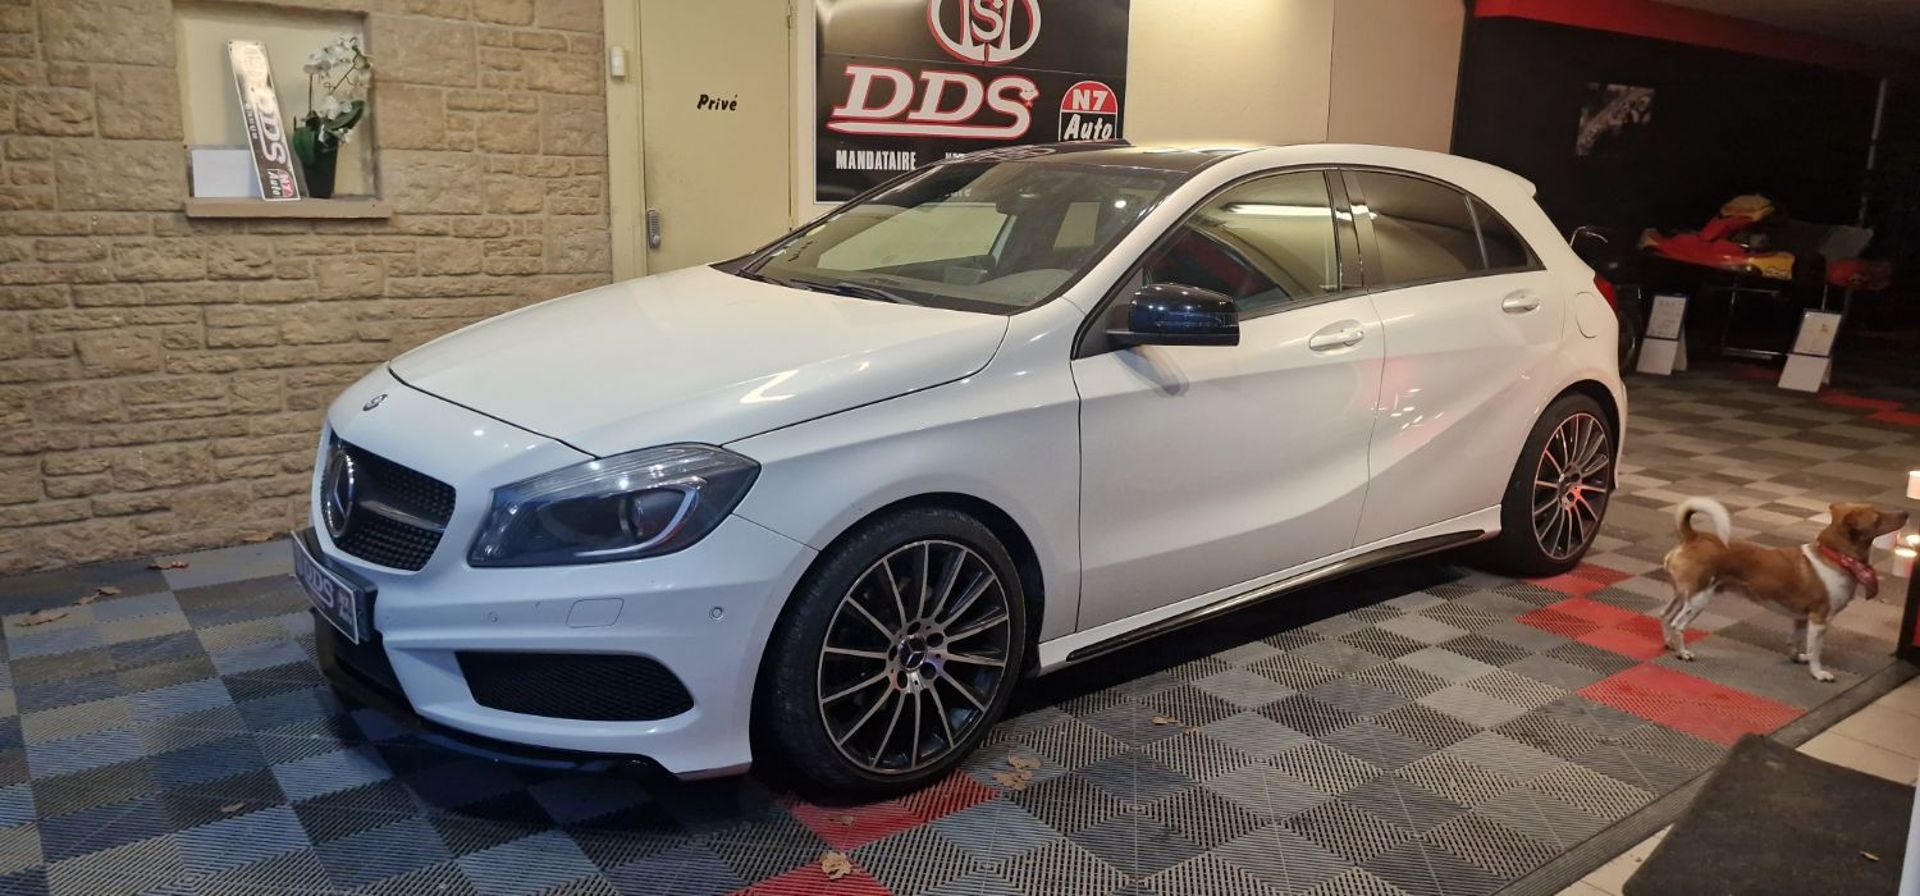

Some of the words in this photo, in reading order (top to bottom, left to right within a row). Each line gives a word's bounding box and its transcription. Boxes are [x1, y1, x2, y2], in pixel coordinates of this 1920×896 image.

[697, 93, 738, 111] Privé
[828, 66, 1039, 139] DDS
[1072, 88, 1108, 111] N7
[1063, 113, 1113, 140] Auto
[836, 150, 917, 171] MANDATAIRE
